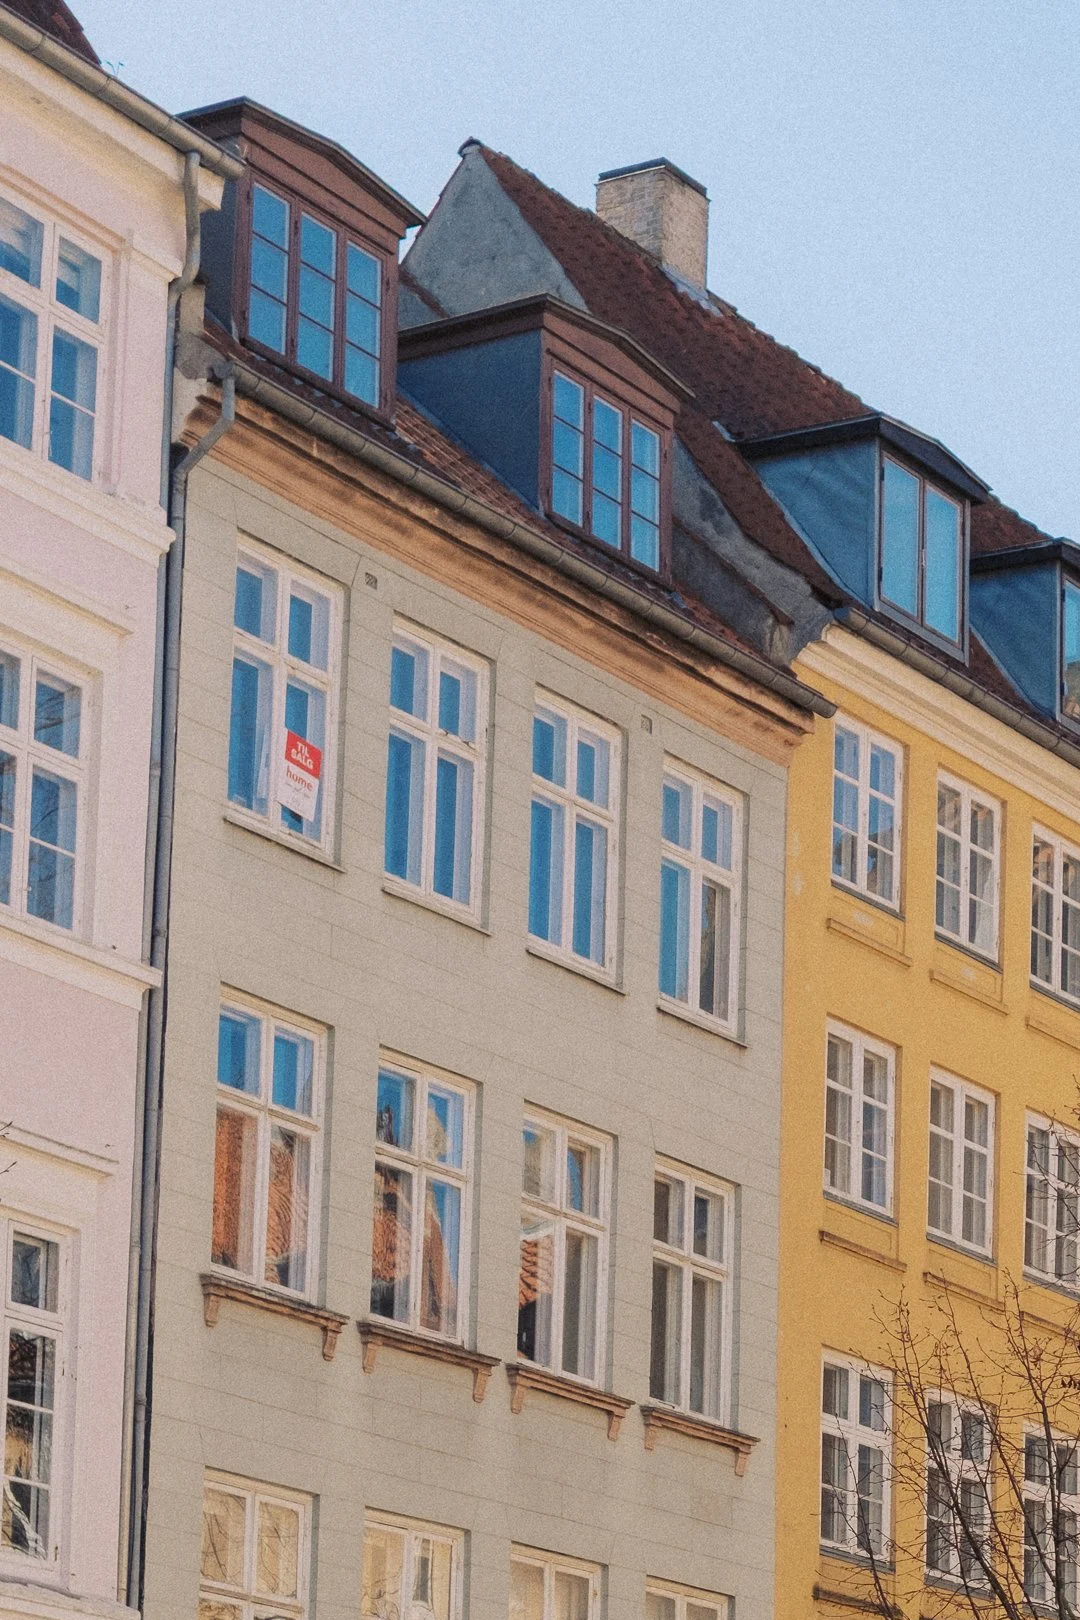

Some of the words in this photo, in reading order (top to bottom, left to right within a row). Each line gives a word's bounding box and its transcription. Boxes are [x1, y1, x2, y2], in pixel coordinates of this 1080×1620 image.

[291, 748, 314, 770] SALG
[297, 741, 310, 758] TIL
[286, 765, 313, 791] home
